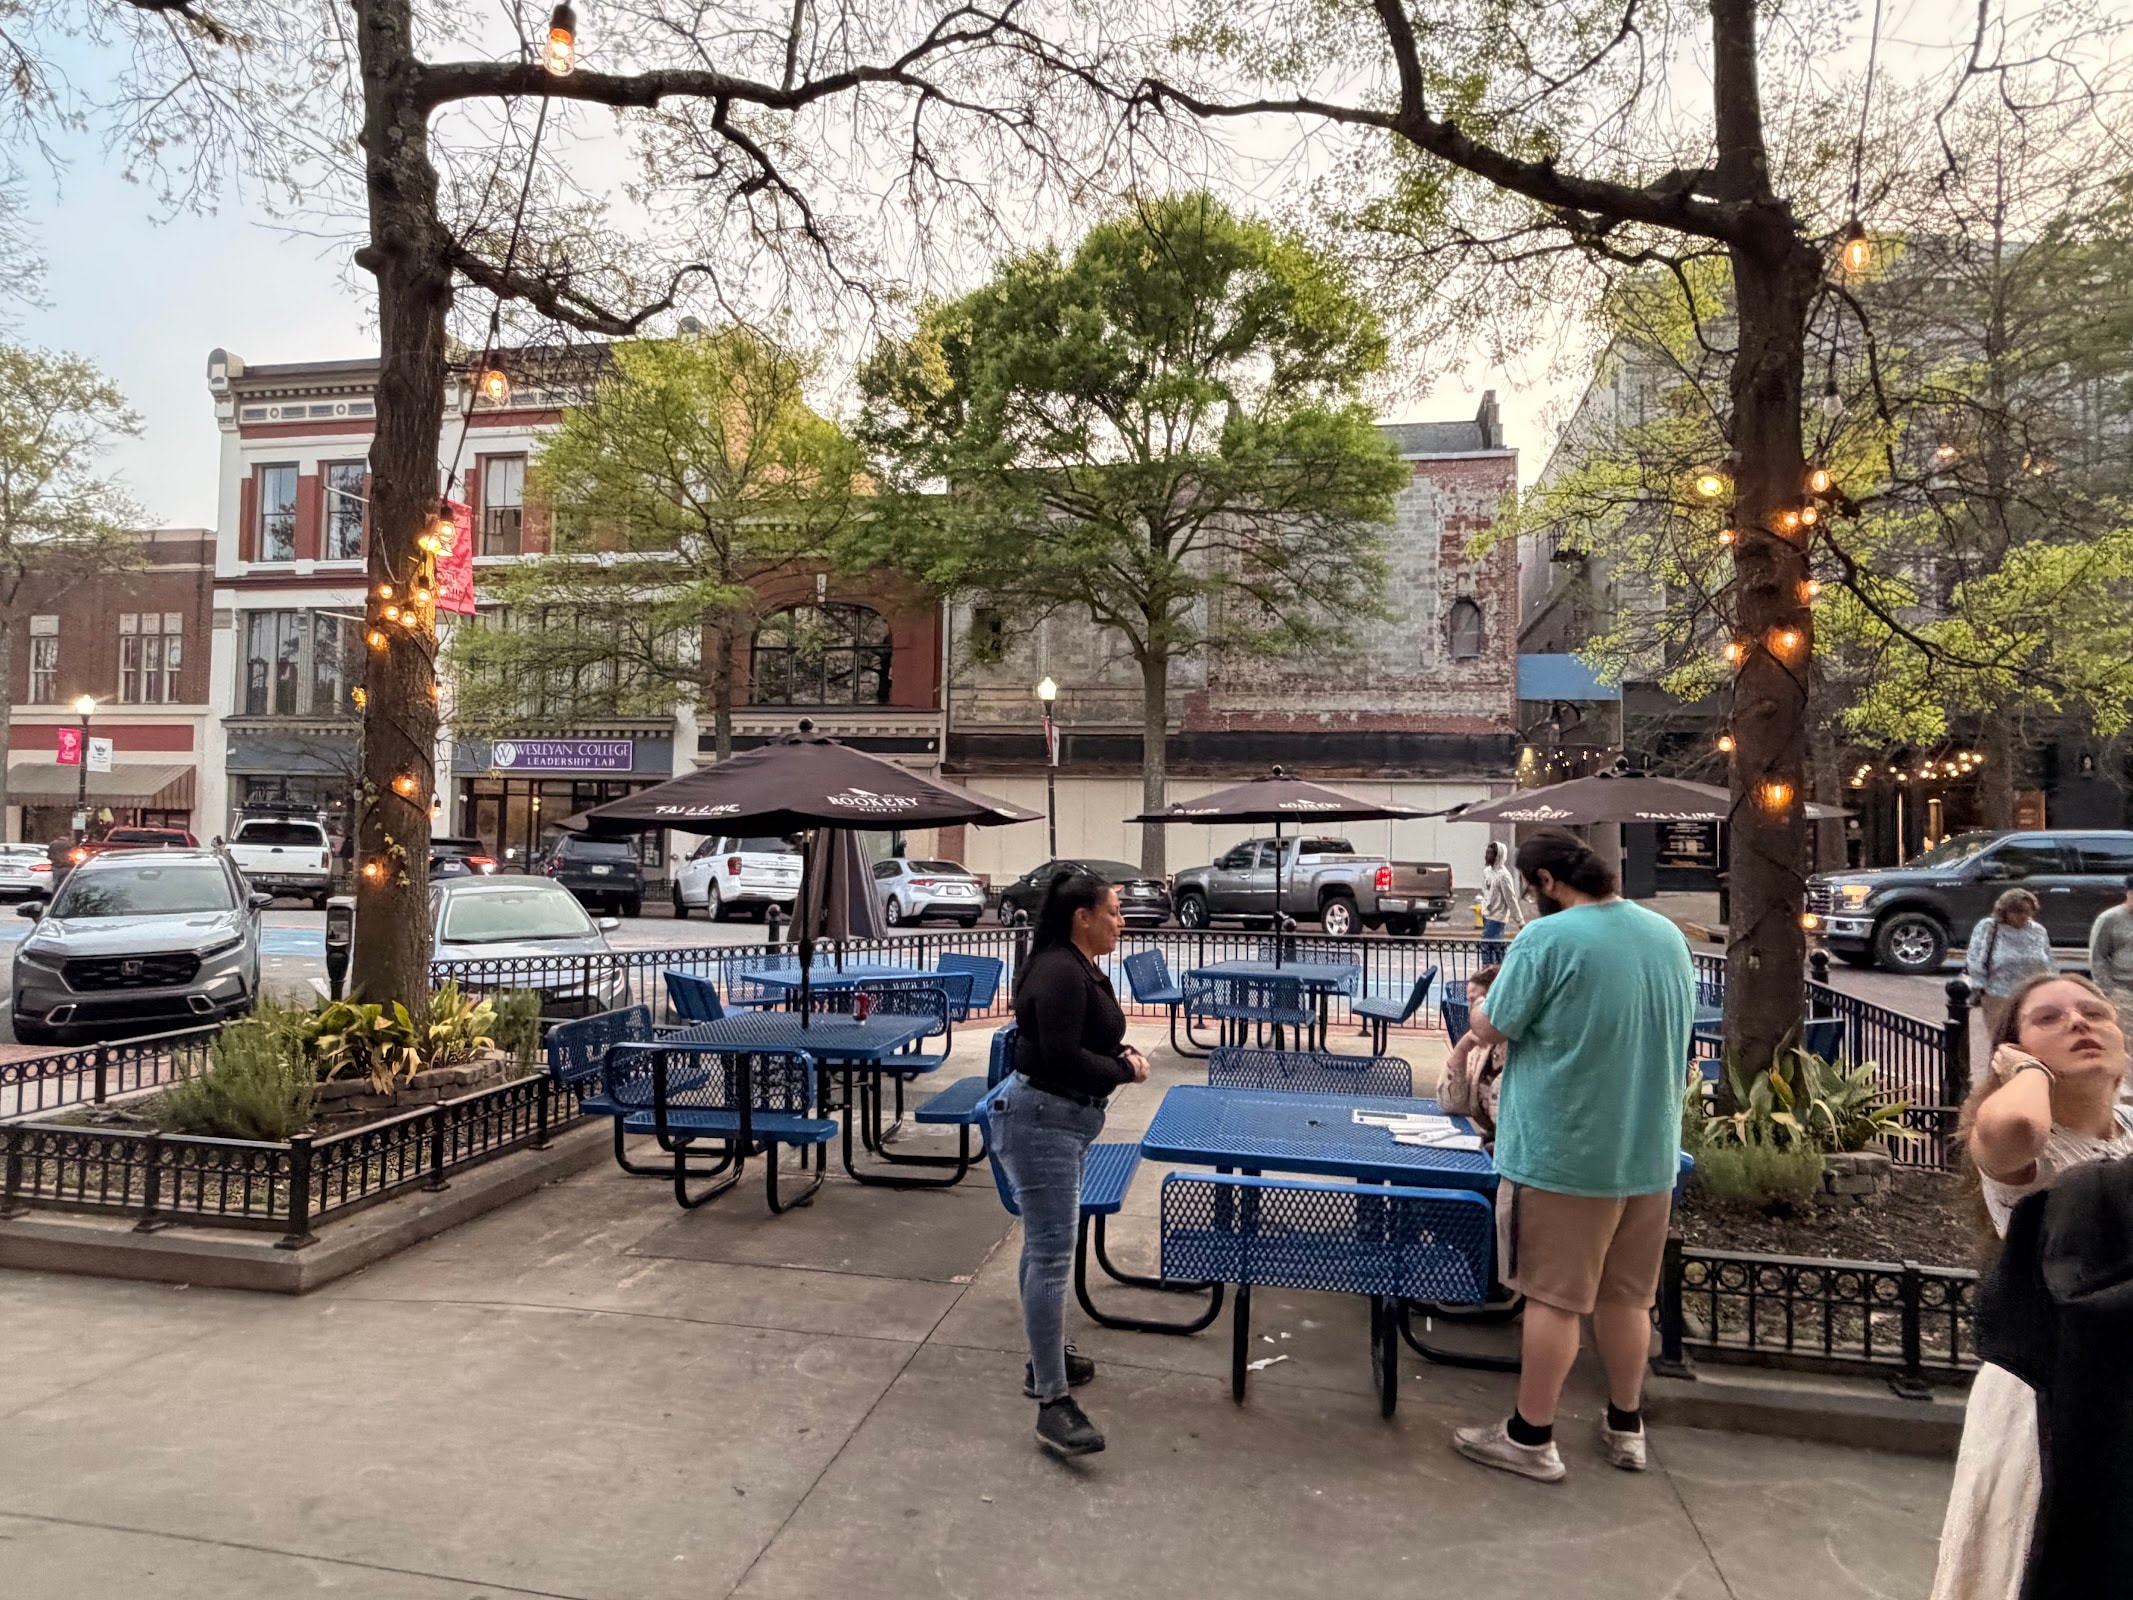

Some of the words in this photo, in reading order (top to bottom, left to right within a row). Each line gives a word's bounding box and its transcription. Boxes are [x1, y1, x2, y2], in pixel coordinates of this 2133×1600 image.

[514, 744, 572, 756] WESLEYAN
[578, 744, 629, 756] COLLEGE
[527, 757, 591, 766] LEADERSHIP
[595, 758, 615, 767] LAB
[826, 796, 919, 808] ROOKERY
